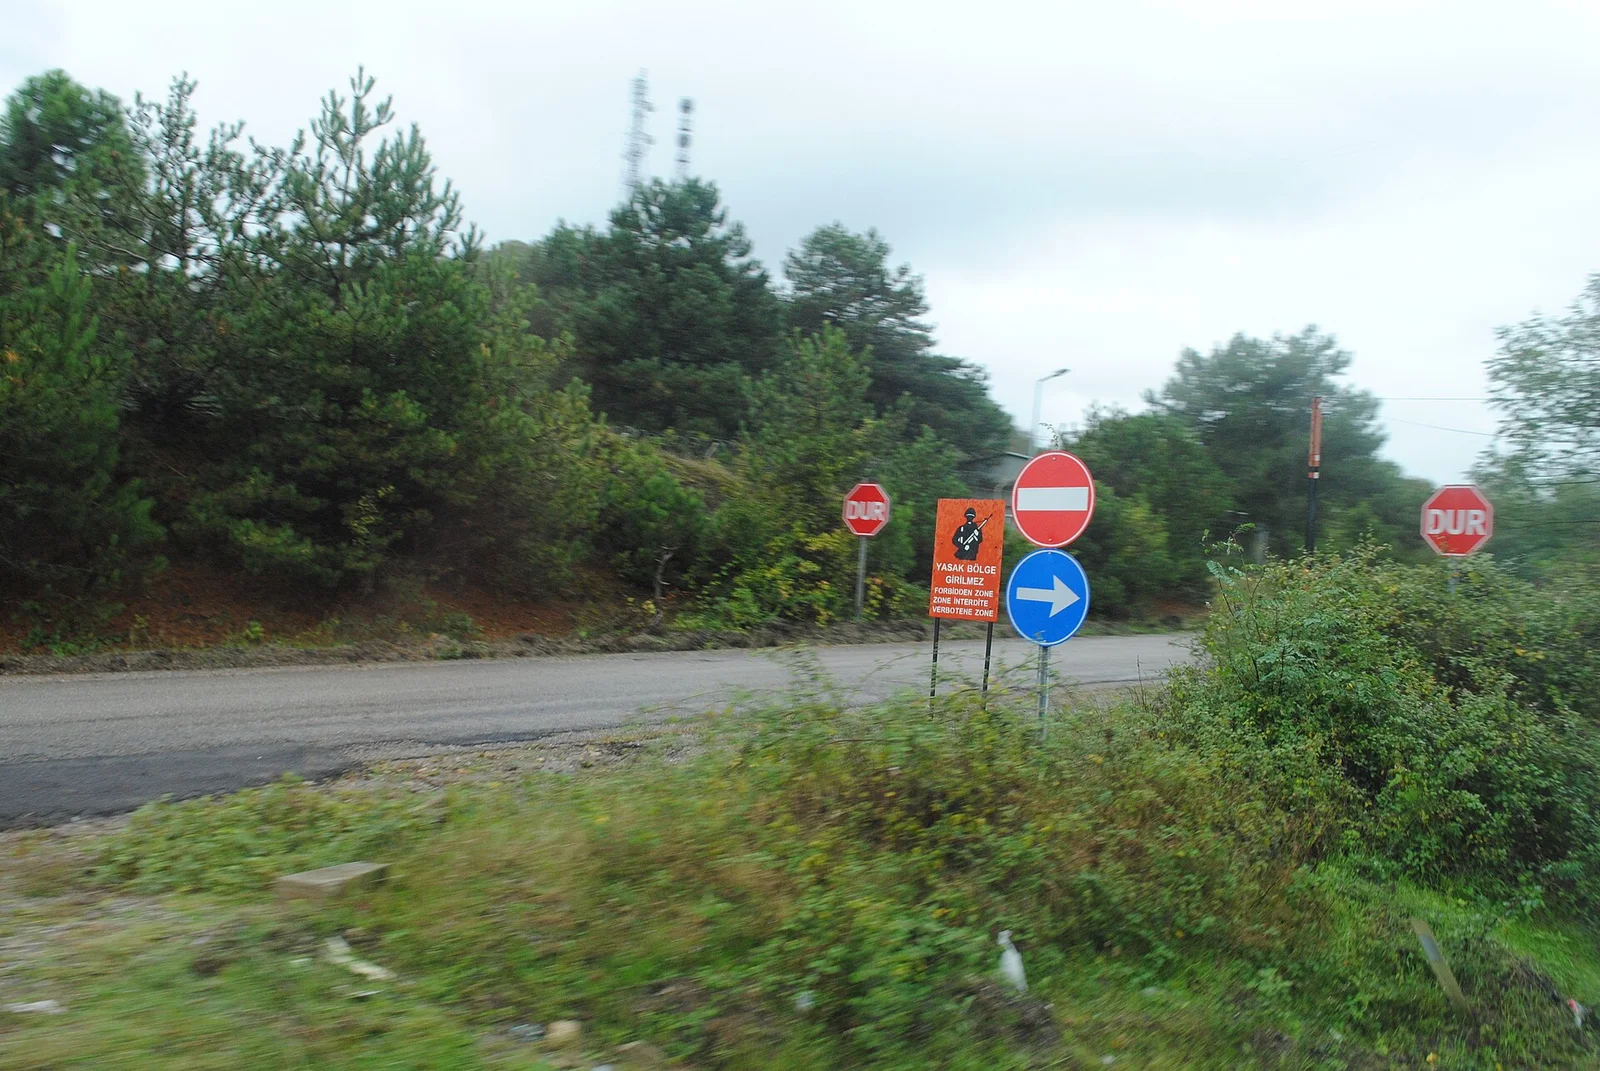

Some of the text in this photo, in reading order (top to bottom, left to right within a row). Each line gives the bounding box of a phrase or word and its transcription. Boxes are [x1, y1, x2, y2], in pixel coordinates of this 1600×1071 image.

[846, 501, 885, 520] DUR
[1427, 509, 1486, 535] DUR
[936, 563, 996, 574] YASAK BÖLGE
[945, 575, 984, 586] GİRİLMEZ
[933, 596, 951, 604] ZONE
[932, 606, 993, 617] VERBOTENE ZONE
